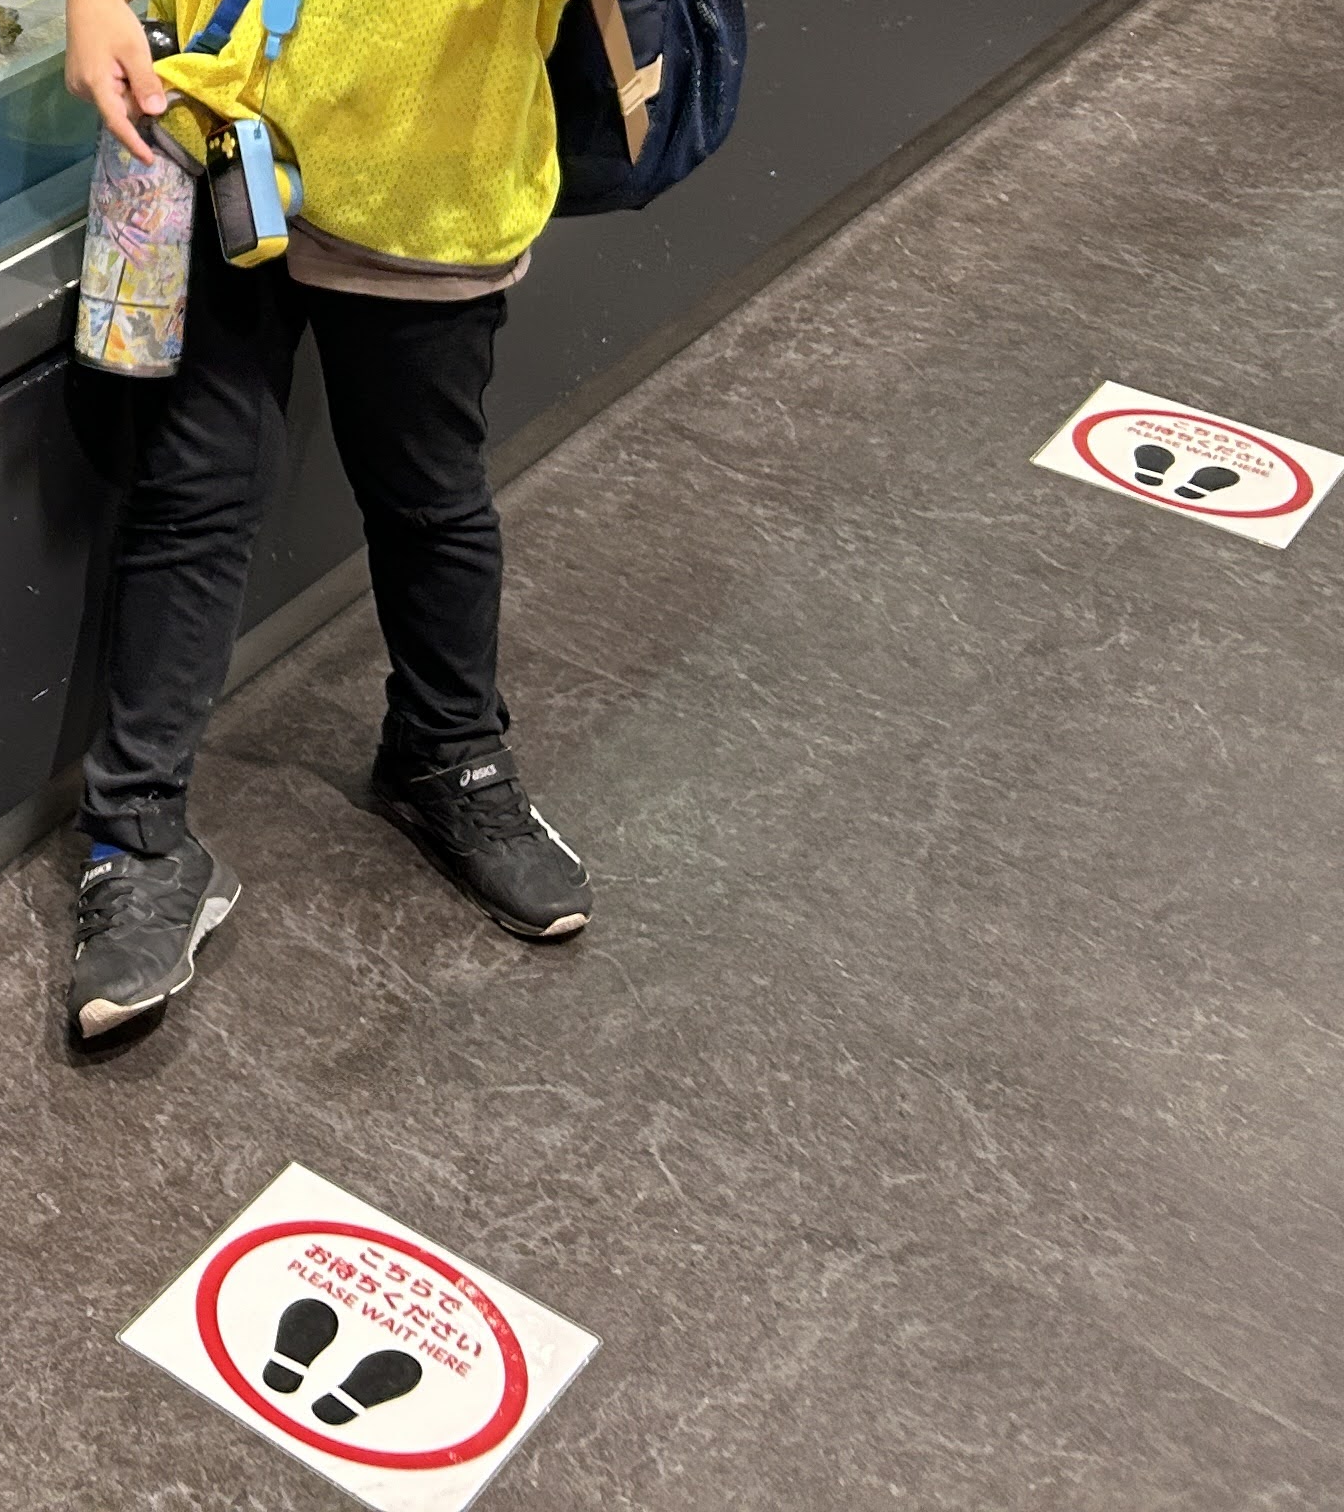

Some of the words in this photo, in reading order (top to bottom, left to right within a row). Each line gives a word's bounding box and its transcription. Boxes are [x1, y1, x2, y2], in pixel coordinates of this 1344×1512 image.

[1126, 426, 1181, 449] PLEASE
[1186, 445, 1229, 462] WAIT
[1232, 460, 1270, 477] HERE
[287, 1259, 359, 1309] PLEASE
[361, 1302, 418, 1342] WAIT
[419, 1338, 472, 1377] HERE
[304, 1243, 482, 1357] お待ちください
[359, 1246, 463, 1314] こちらで
